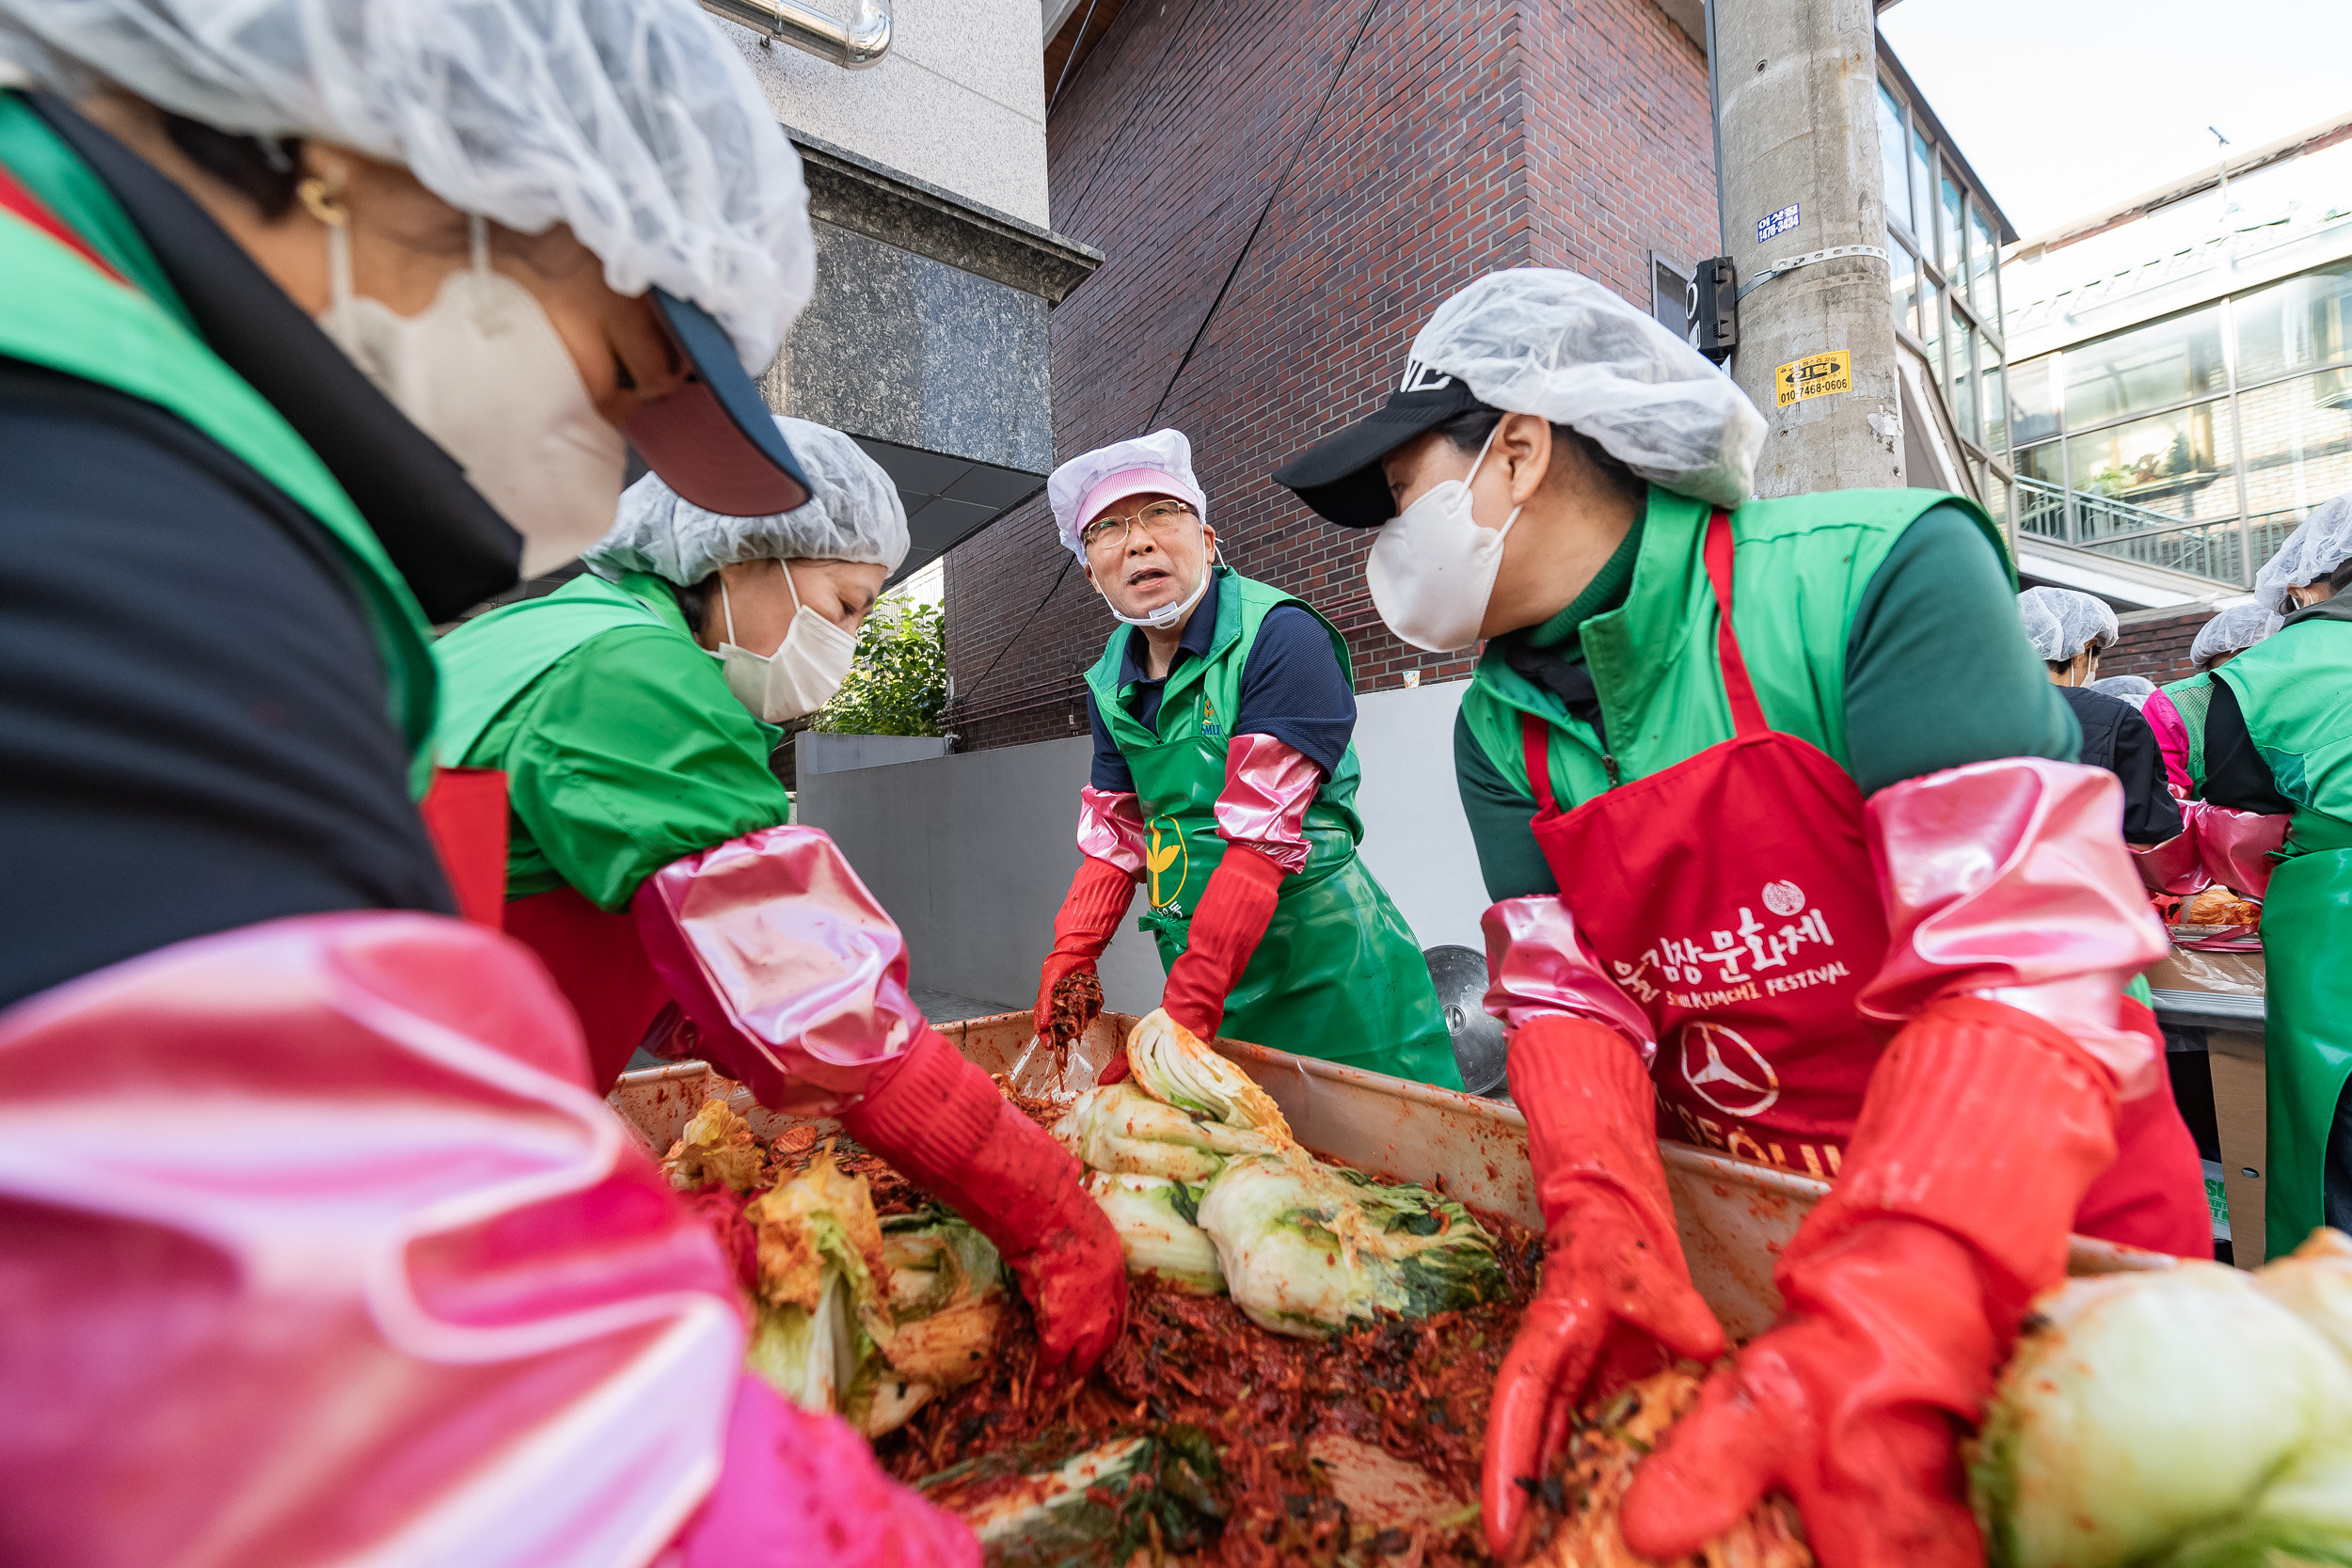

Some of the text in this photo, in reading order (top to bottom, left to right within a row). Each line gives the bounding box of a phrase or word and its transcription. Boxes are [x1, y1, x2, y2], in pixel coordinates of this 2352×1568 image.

[1758, 204, 1798, 230] 이삿짐
[1781, 378, 1848, 403] 010-7468-0606
[1764, 959, 1851, 997] FESTIVAL
